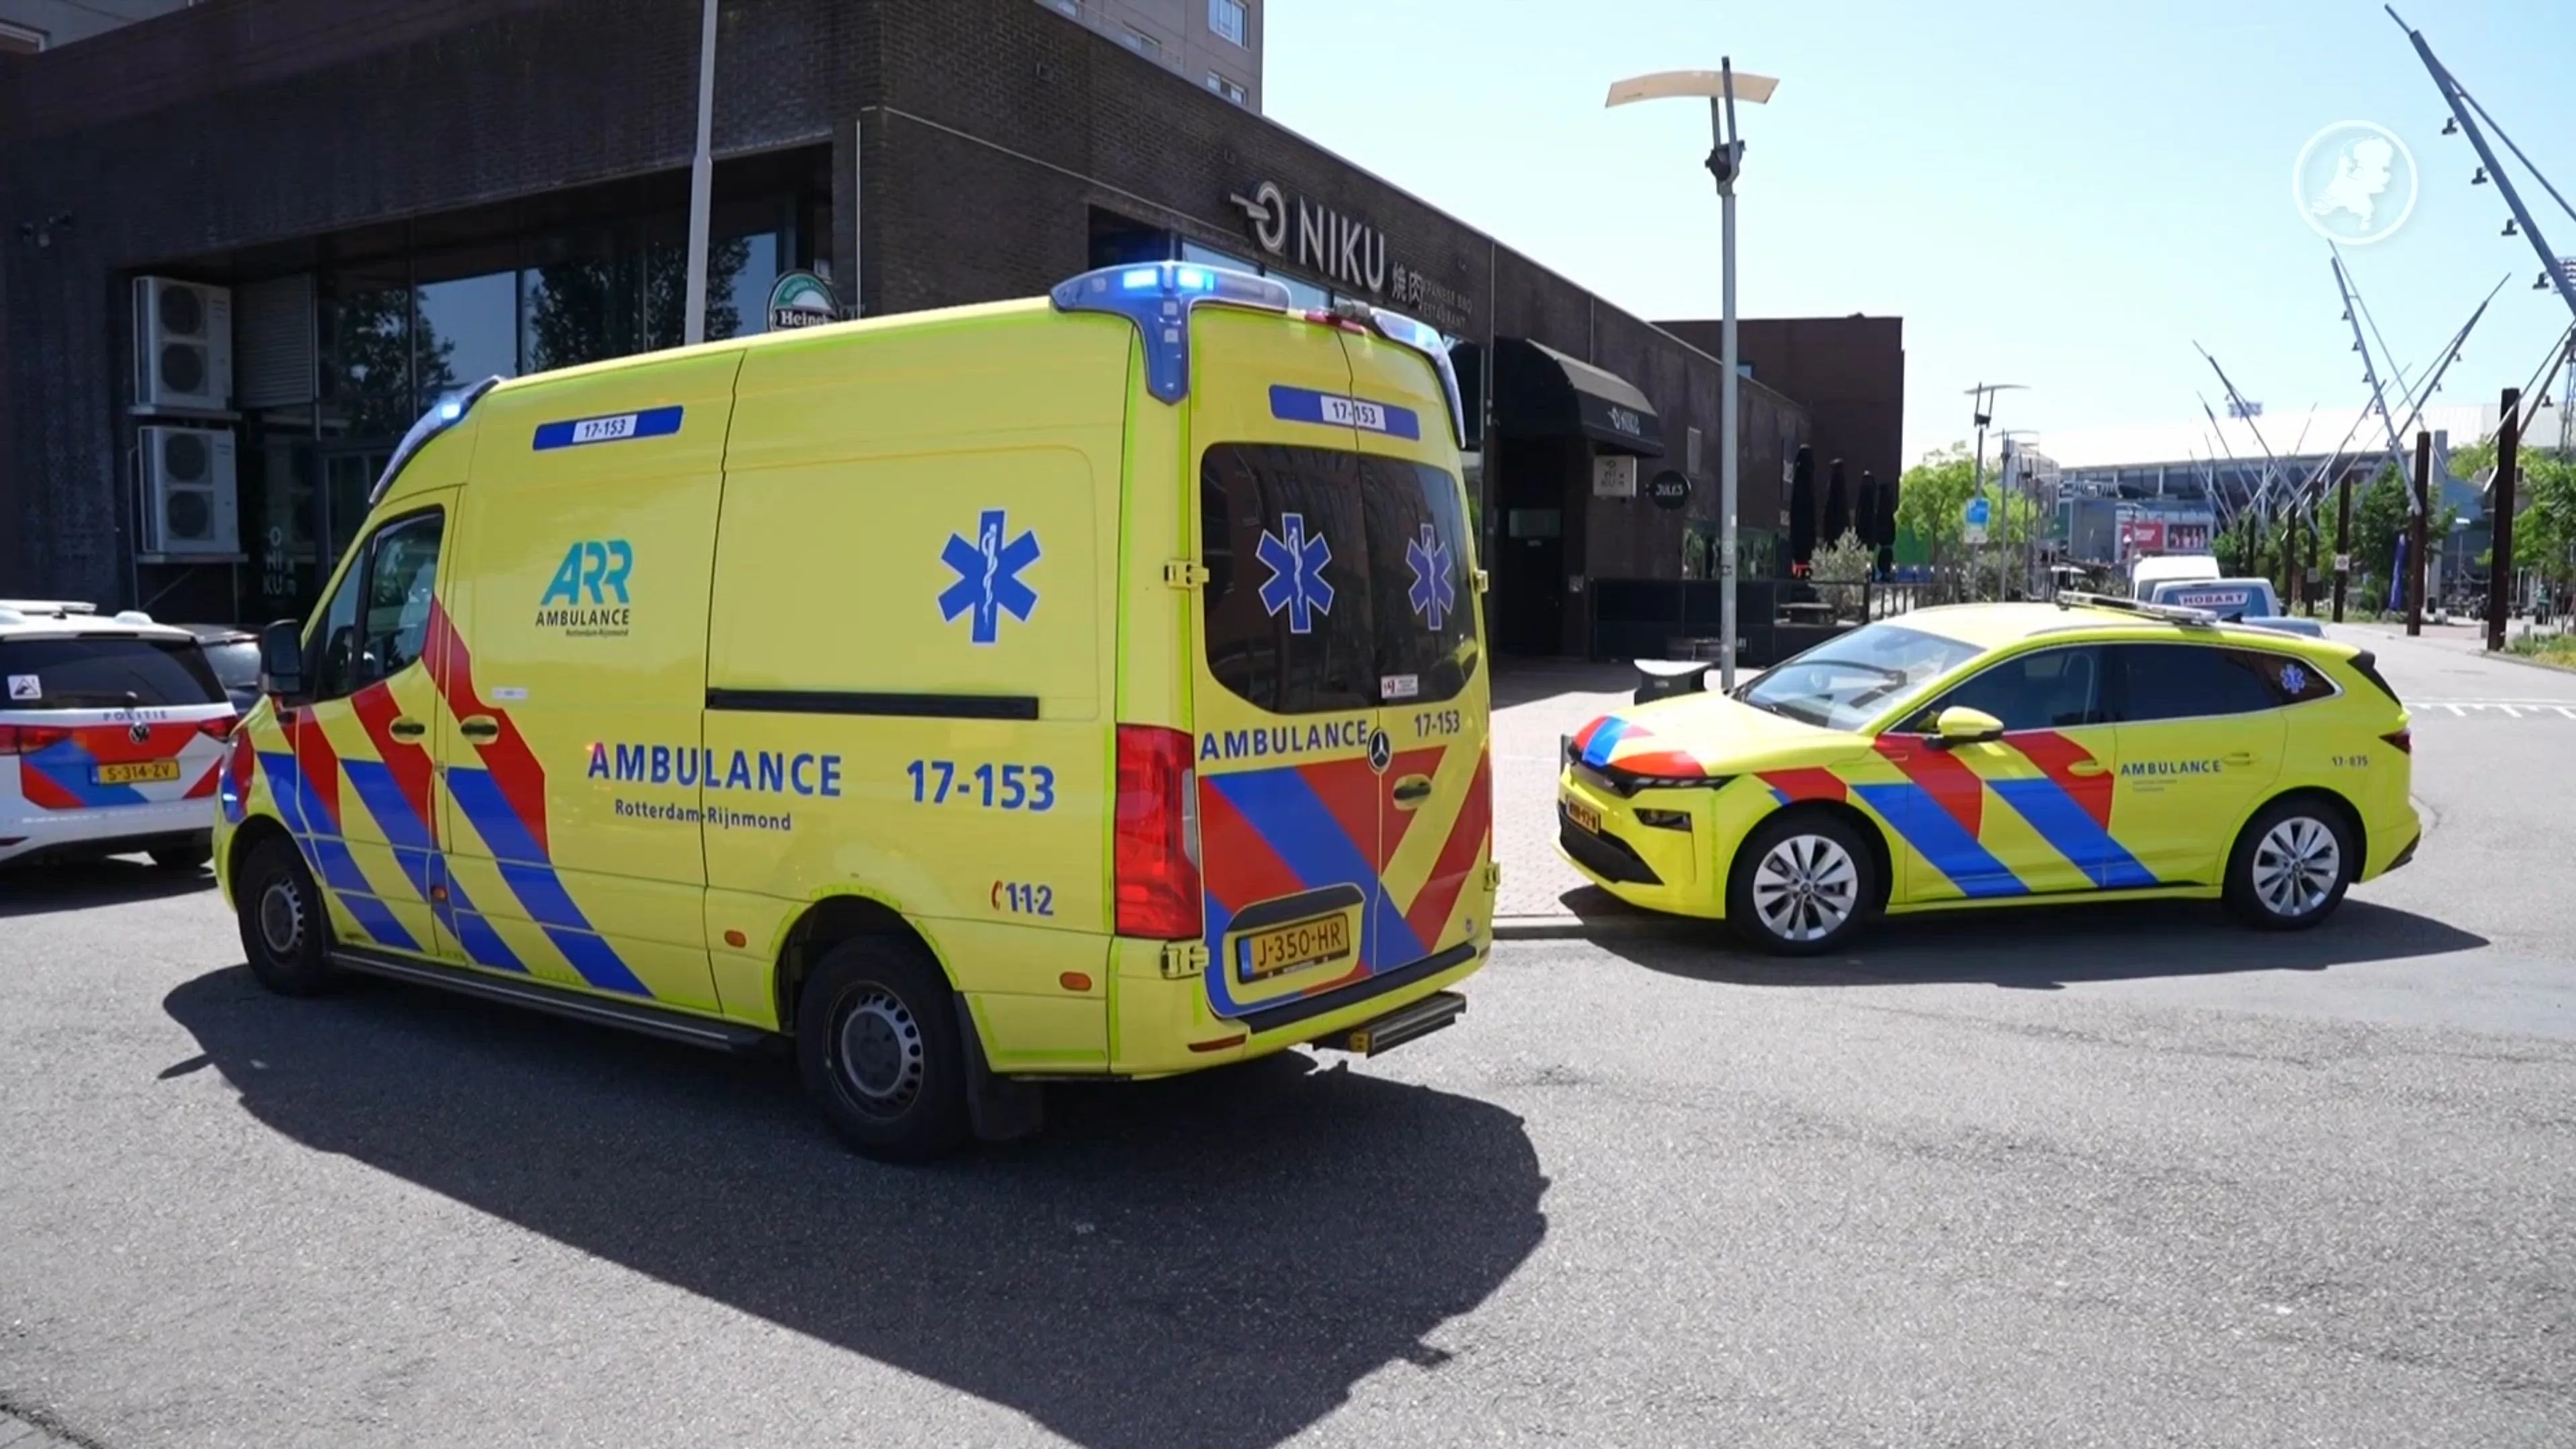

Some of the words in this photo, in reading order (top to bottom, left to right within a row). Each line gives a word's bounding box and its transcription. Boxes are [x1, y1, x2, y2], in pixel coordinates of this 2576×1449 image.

[1300, 195, 1384, 292] NIKU
[584, 419, 626, 438] 17-153
[1333, 402, 1376, 425] 17-153
[540, 539, 633, 606] ARR
[2183, 594, 2243, 604] HOBART
[535, 608, 630, 627] AMBULANCE
[103, 710, 167, 720] POLITIE
[1199, 720, 1367, 760] AMBULANCE
[1414, 710, 1460, 737] 17-153
[588, 742, 841, 796] AMBULANCE
[2121, 760, 2222, 775] AMBULANCE
[906, 759, 1055, 812] 17-153
[615, 799, 792, 830] Rotterdam-Rijnmond
[1258, 923, 1342, 967] J-350-HR
